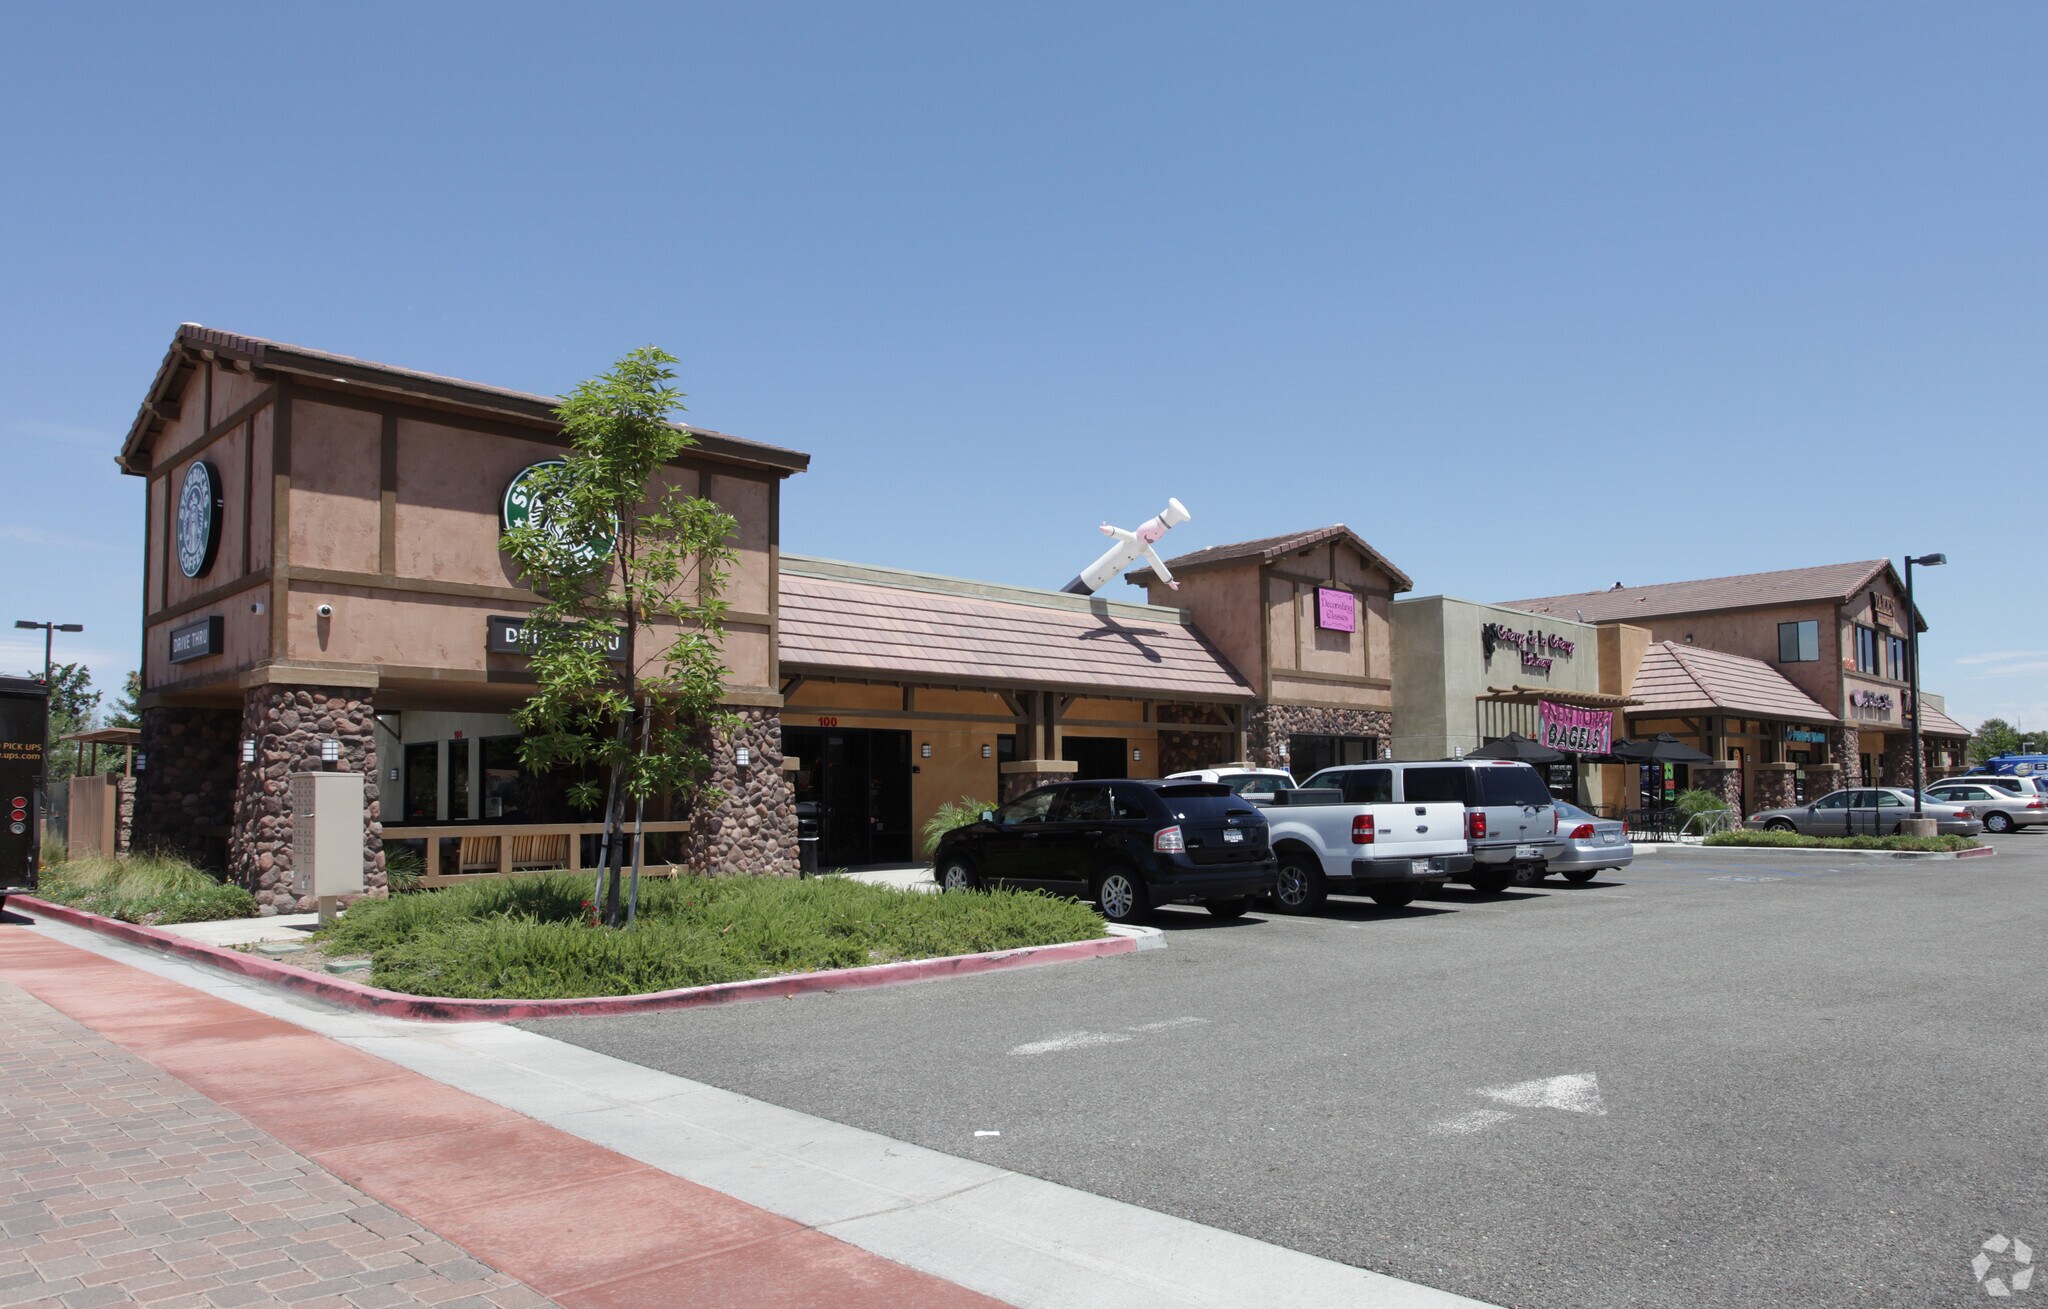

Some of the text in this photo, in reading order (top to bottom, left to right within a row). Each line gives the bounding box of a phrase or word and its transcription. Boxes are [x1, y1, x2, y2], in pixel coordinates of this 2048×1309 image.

[181, 541, 205, 571] COFFEE
[1321, 597, 1353, 615] Decorating
[1326, 609, 1349, 622] Classes
[173, 628, 208, 653] DRIVE THRU
[817, 716, 838, 727] 100
[1548, 702, 1604, 728] NEW YORK
[3, 742, 42, 751] PICK UPS
[1546, 722, 1601, 752] BAGELS
